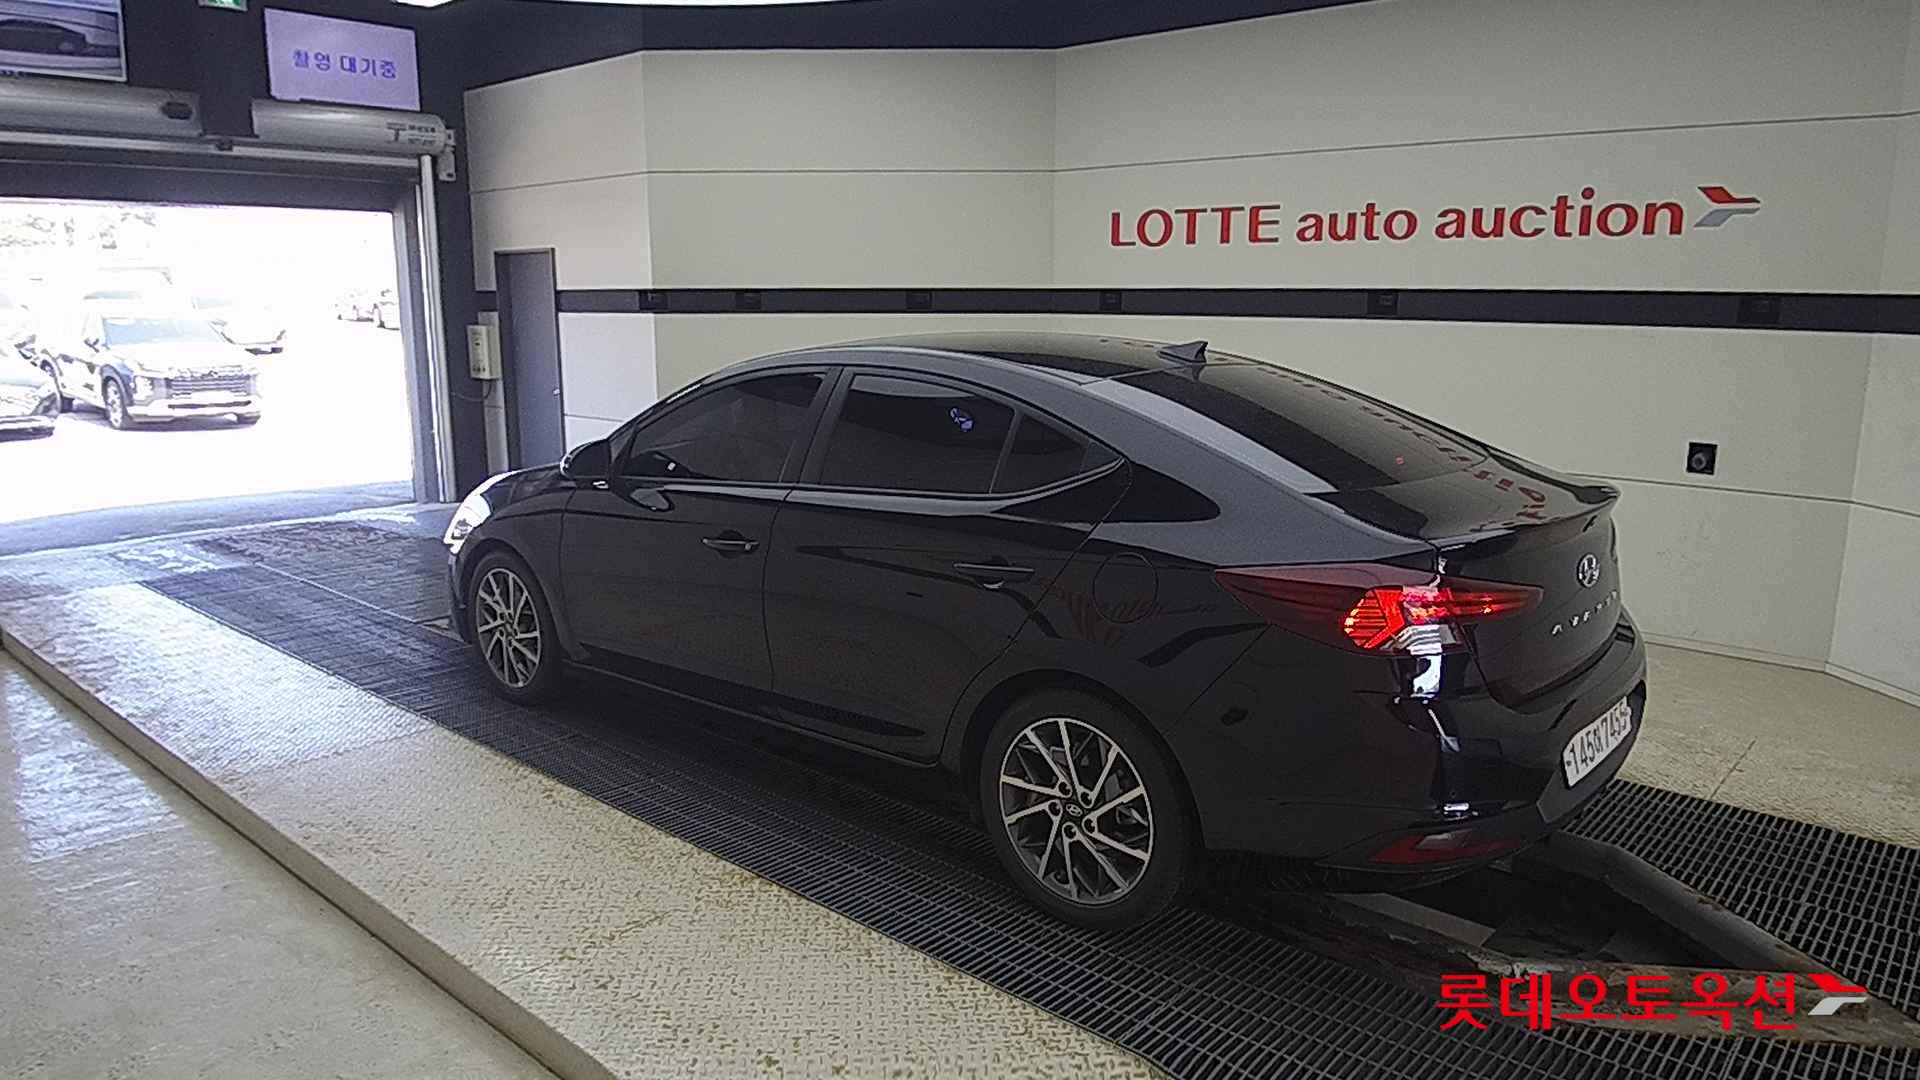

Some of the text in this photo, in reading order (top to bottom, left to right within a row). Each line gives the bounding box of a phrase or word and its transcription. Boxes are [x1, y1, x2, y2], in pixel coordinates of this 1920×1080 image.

[293, 49, 397, 79] 촬영 대기중
[1111, 187, 1684, 247] LOTTE auto auction
